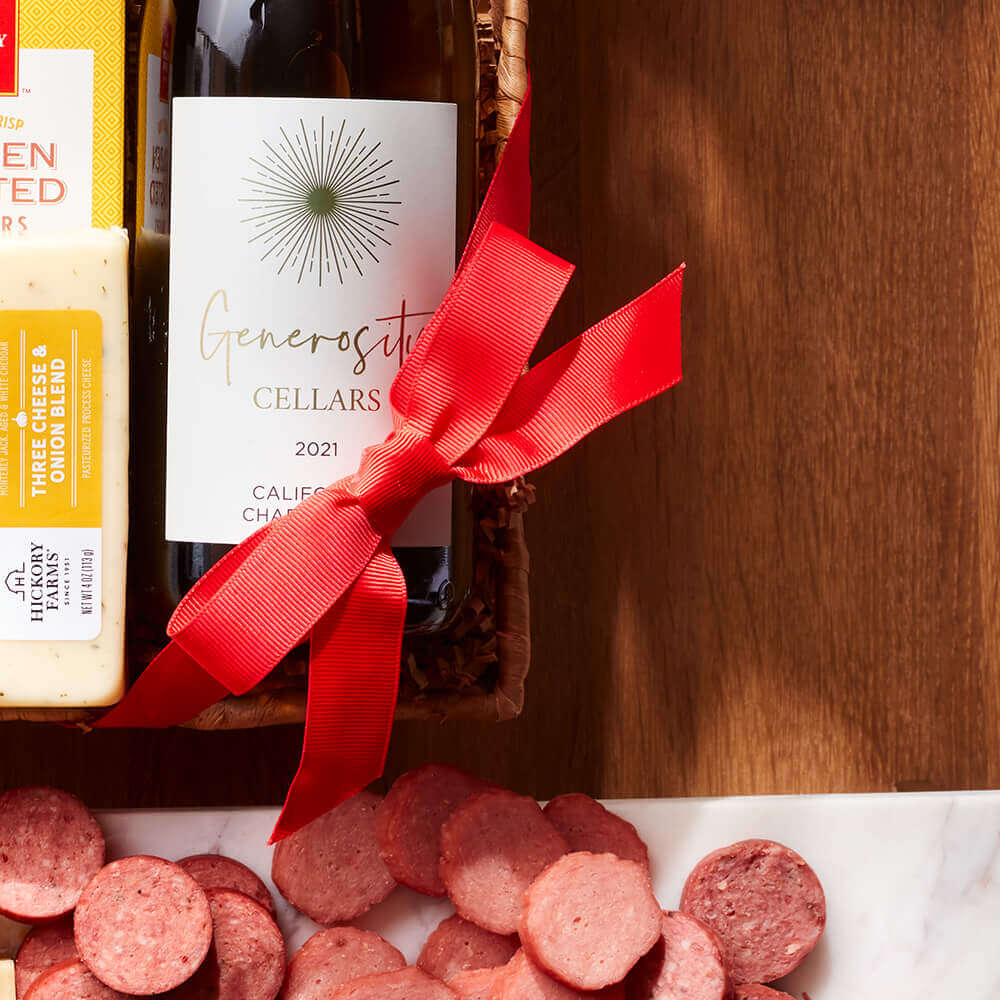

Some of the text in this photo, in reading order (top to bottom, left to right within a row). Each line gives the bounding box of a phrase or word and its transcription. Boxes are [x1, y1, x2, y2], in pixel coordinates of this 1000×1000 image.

[0, 342, 9, 376] CHEDDAR
[0, 378, 9, 401] WHITE
[253, 387, 381, 412] CELLARS
[32, 345, 47, 497] THREE CHEESE &
[50, 358, 65, 483] ONION BLEND
[81, 358, 92, 479] PASTEURIZED PROCESS CHEESE
[295, 441, 338, 457] 2021
[0, 458, 9, 496] MONTEREY
[30, 542, 43, 622] HICKORY
[46, 552, 59, 611] FARMS
[81, 573, 93, 583] OZ
[81, 590, 93, 601] WT
[81, 602, 93, 615] NET
